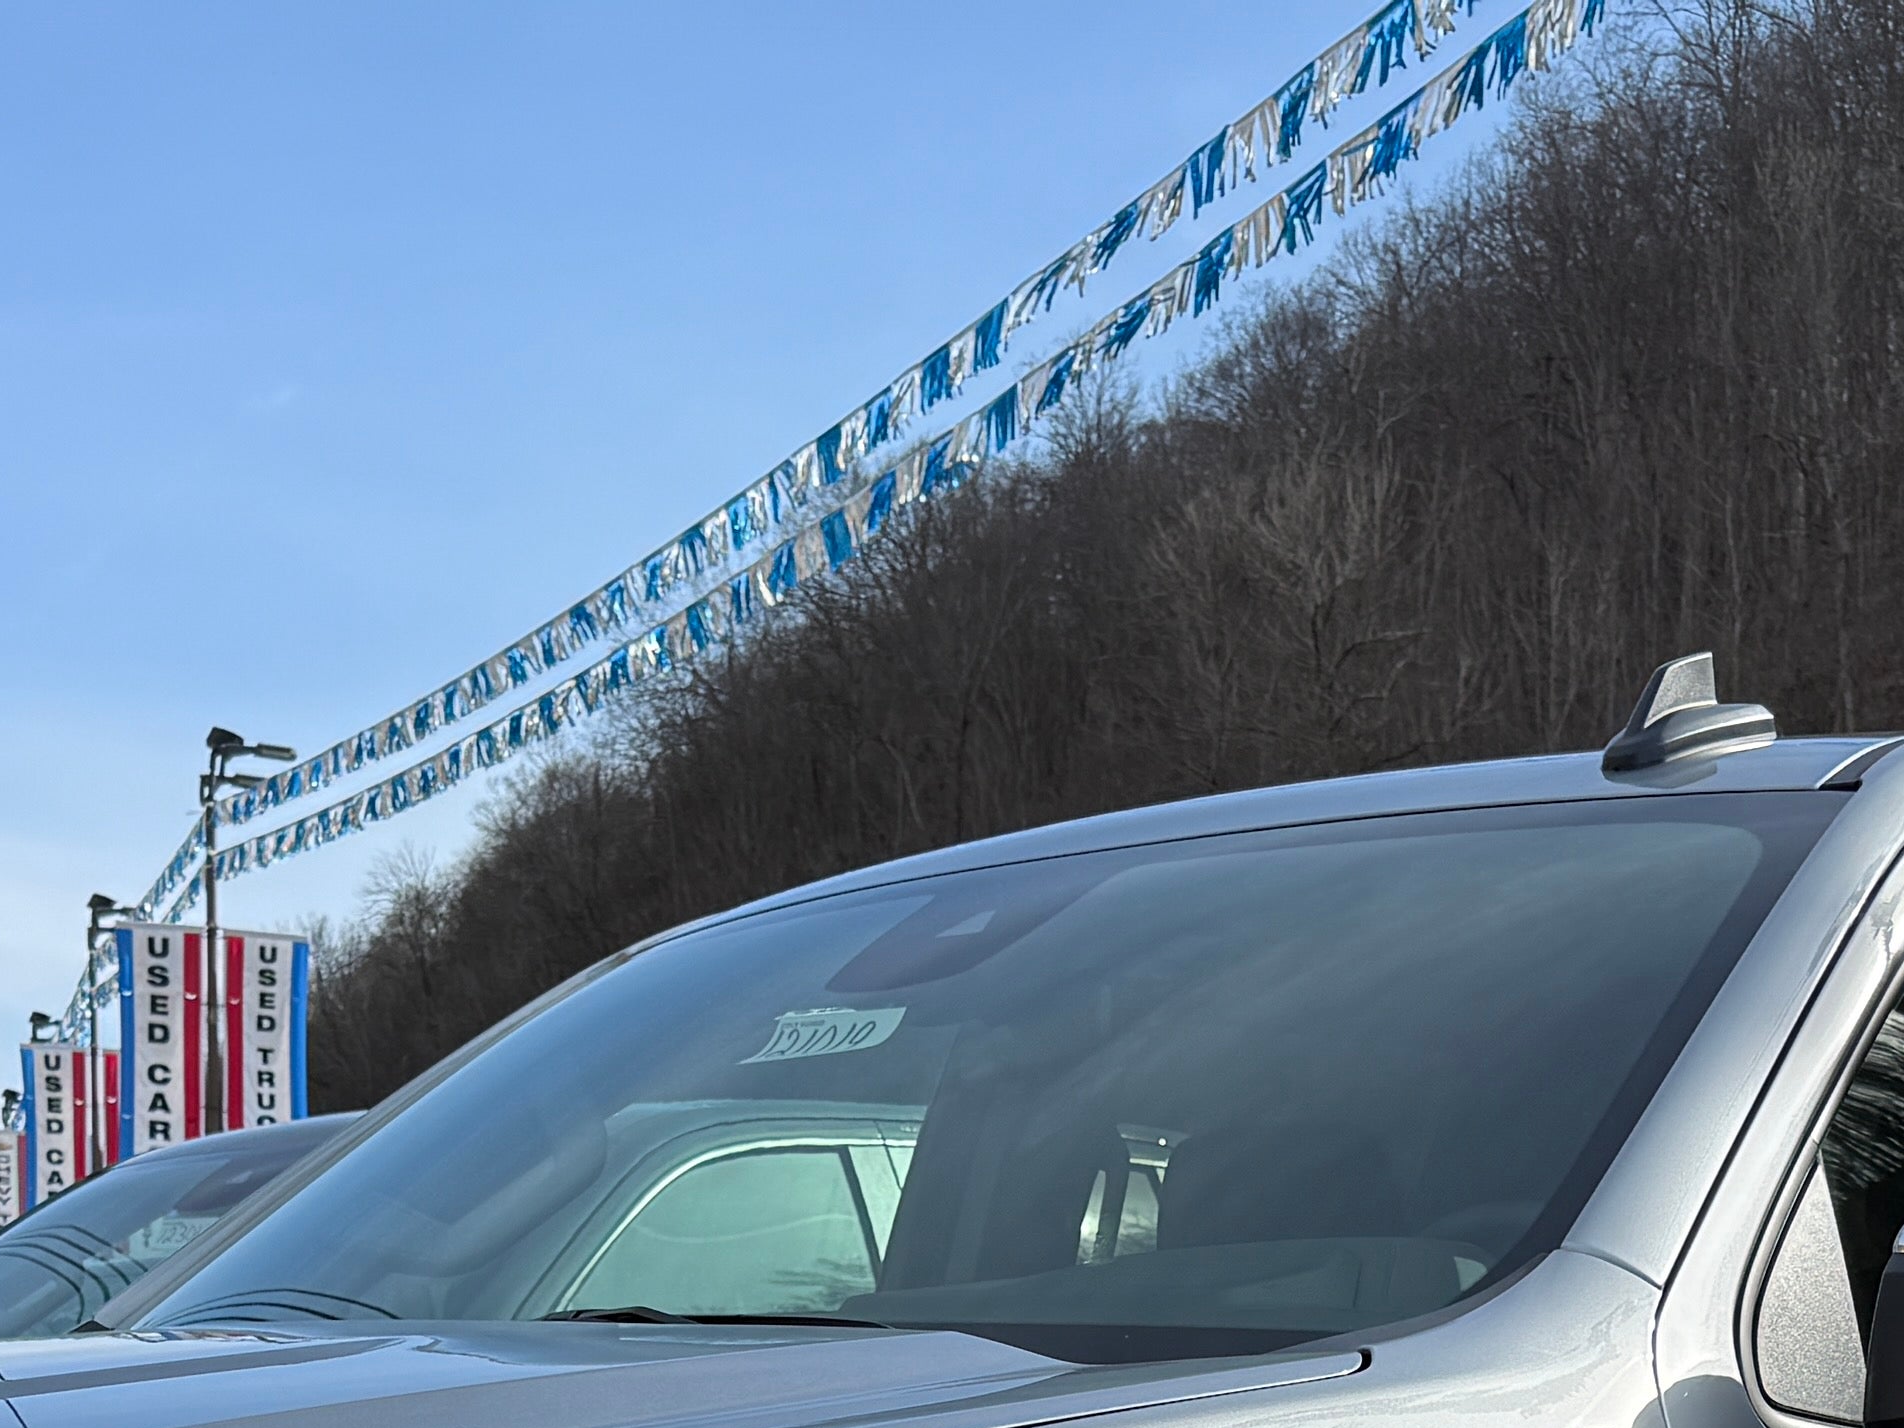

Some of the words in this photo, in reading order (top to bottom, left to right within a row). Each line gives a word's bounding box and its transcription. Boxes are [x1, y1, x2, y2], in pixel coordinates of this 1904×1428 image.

[147, 937, 171, 1044] USED
[256, 945, 278, 1033] USED
[43, 1054, 64, 1135] USED
[147, 1063, 172, 1150] CAR
